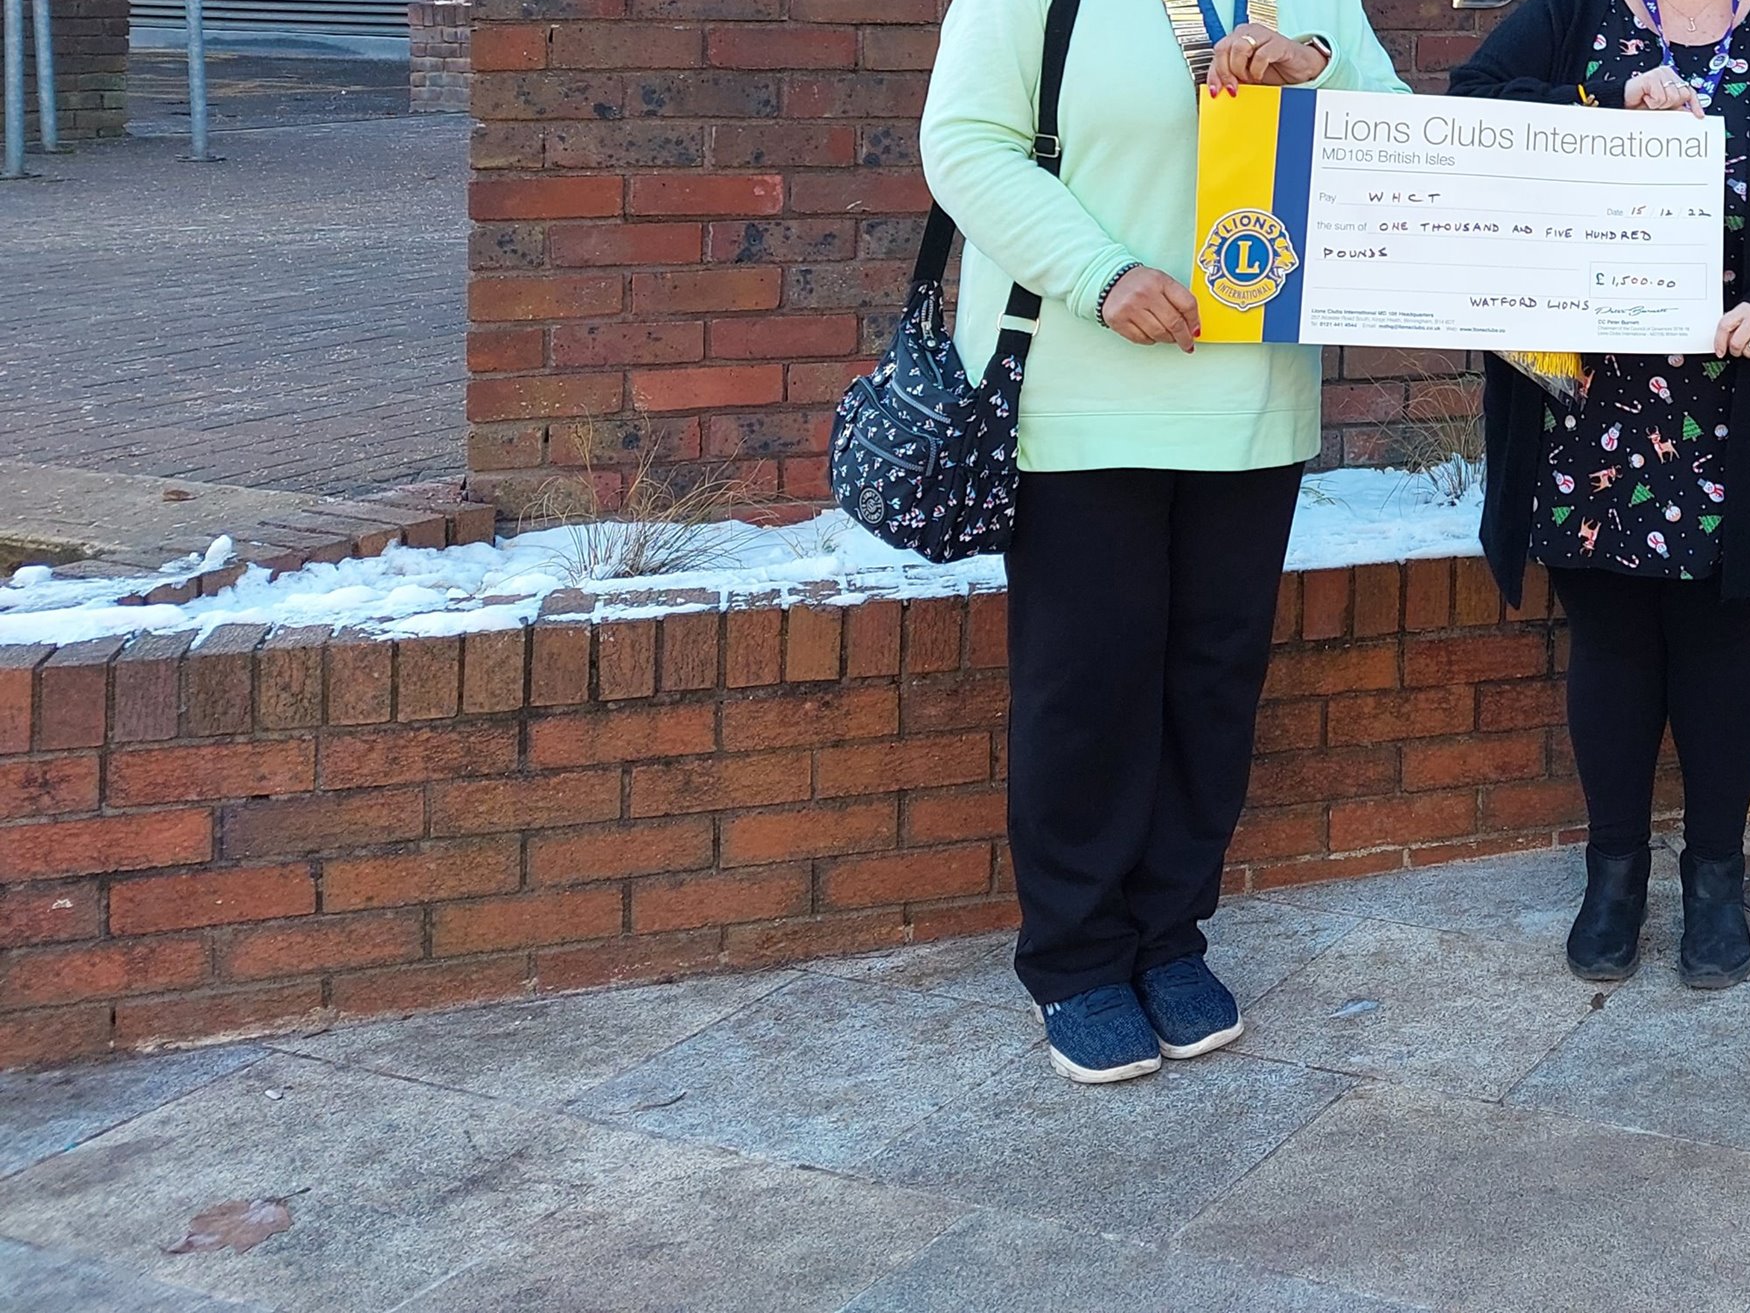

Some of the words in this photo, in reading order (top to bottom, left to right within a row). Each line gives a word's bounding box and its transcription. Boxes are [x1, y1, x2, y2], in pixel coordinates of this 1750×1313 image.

[1323, 110, 1412, 144] Lions
[1423, 116, 1515, 150] Clubs
[1525, 122, 1709, 158] International
[1322, 147, 1373, 163] MD105
[1378, 150, 1421, 165] British
[1425, 152, 1456, 167] Isles
[1319, 192, 1337, 204] Pay
[1606, 207, 1624, 216] Date
[1222, 214, 1277, 236] LIONS
[1317, 221, 1332, 230] the
[1335, 223, 1355, 231] sum
[1358, 223, 1368, 232] of
[1378, 221, 1409, 232] ONE
[1420, 222, 1500, 233] THOUSAND
[1545, 227, 1574, 239] FIVE
[1584, 229, 1652, 242] HUNDRED
[1235, 240, 1260, 274] L
[1323, 247, 1389, 260] POUNDS
[1217, 283, 1271, 301] INTERNATIONAL
[1469, 296, 1538, 308] WATFORD
[1546, 298, 1591, 311] LIONS
